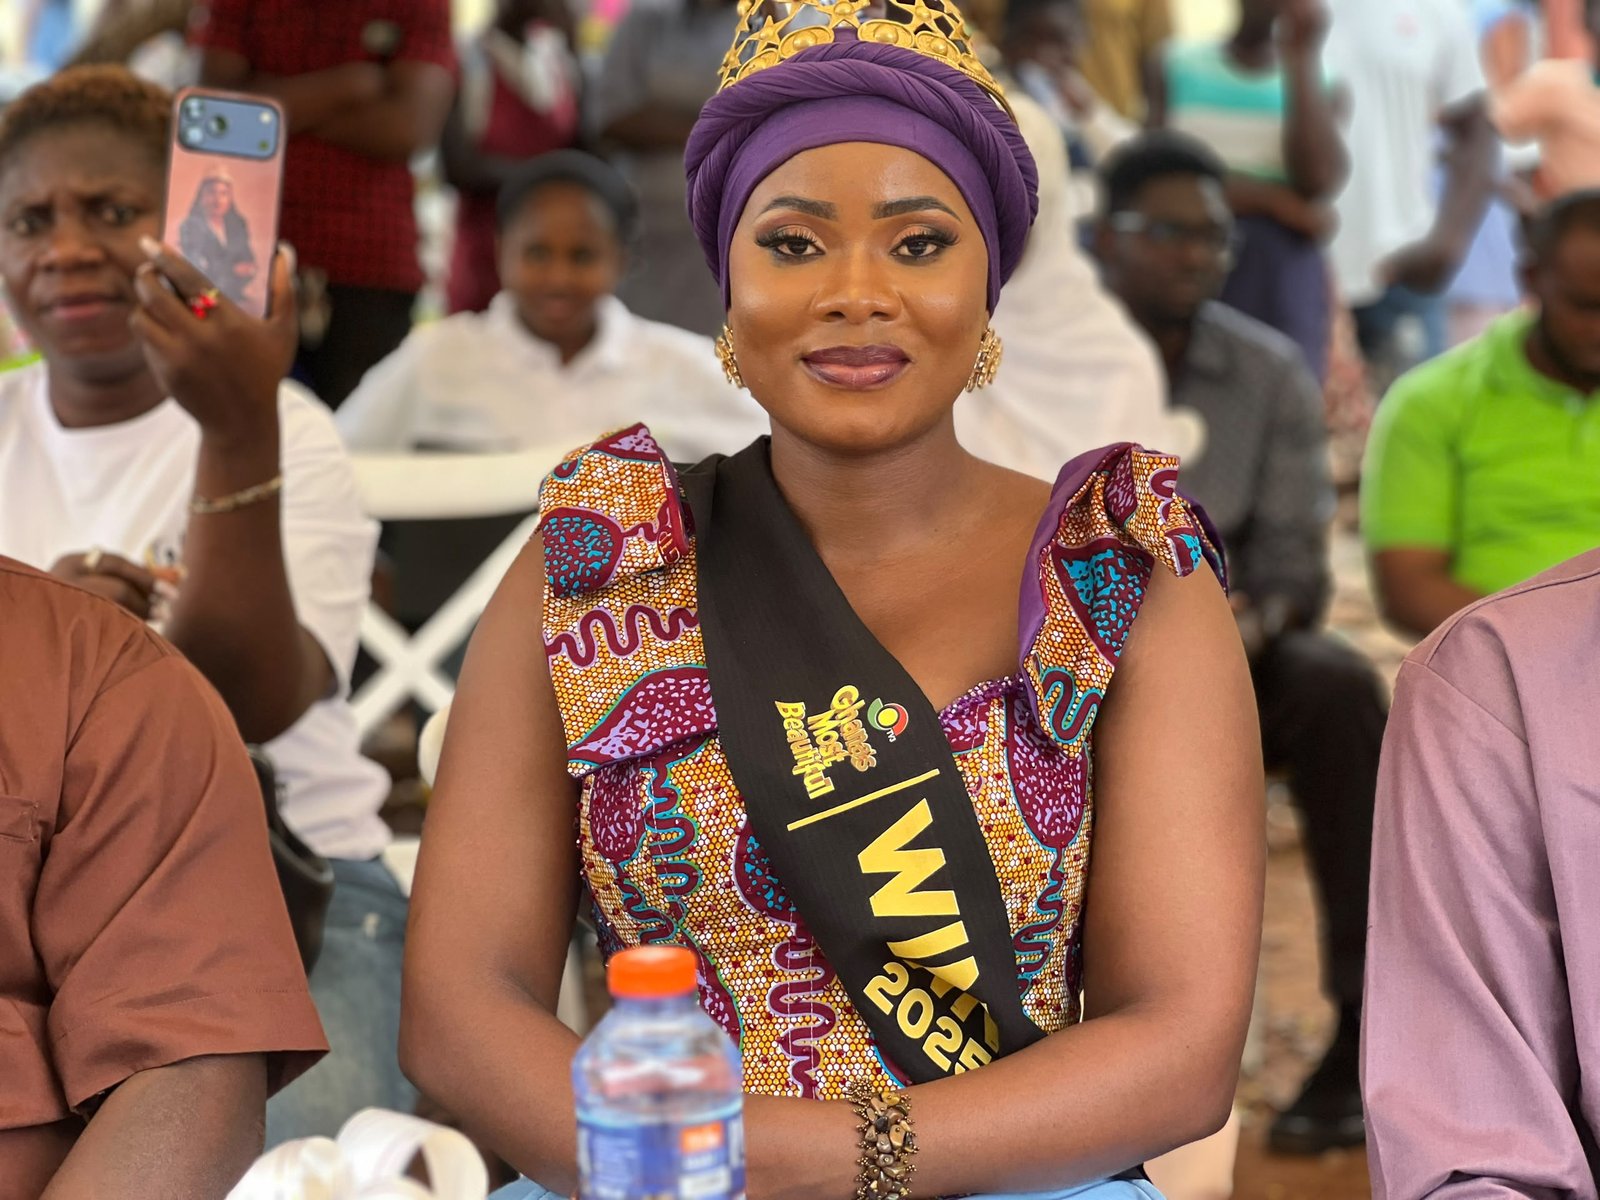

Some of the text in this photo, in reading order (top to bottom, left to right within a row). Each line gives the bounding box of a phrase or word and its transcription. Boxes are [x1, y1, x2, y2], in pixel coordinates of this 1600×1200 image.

[774, 700, 836, 800] Beautiful
[807, 709, 852, 768] Most
[830, 684, 877, 773] Ghana's
[885, 727, 898, 743] TV3
